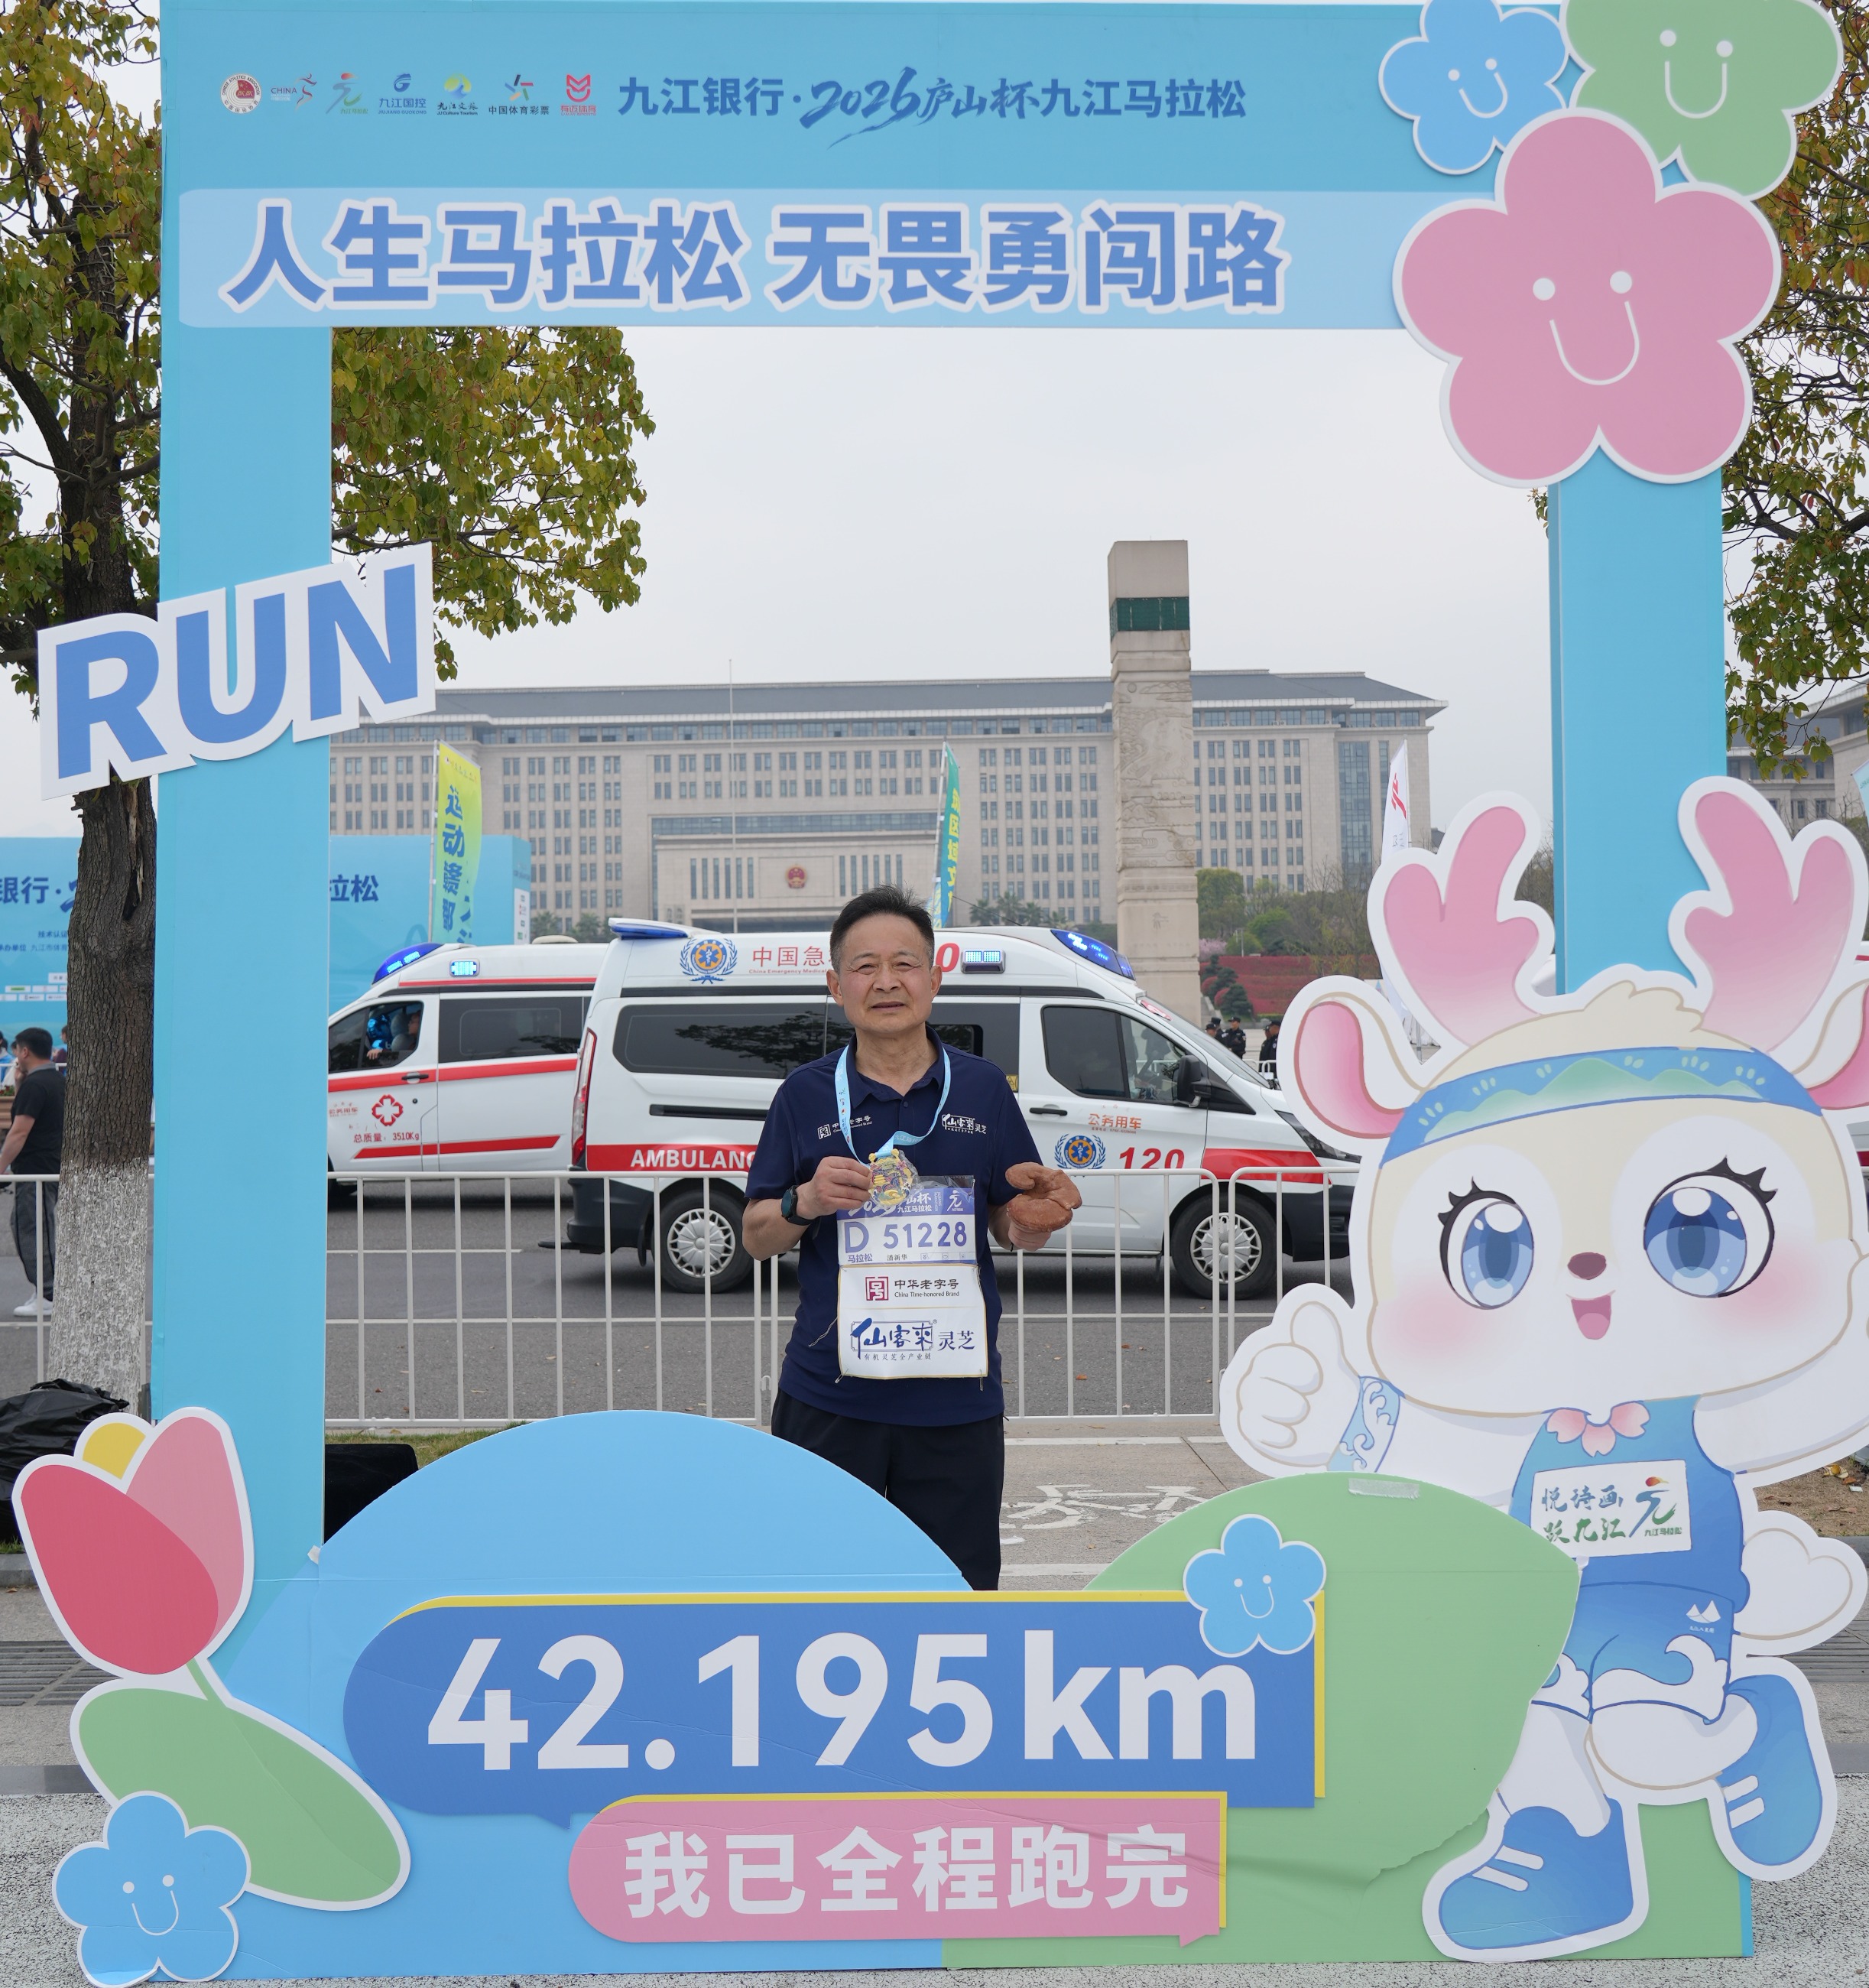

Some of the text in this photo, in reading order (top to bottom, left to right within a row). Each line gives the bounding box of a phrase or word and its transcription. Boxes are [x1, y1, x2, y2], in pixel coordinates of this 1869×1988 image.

[379, 98, 427, 108] 九江国控
[488, 106, 550, 115] 中国体育彩票
[224, 202, 1286, 309] 人生马拉松 无畏勇闯路
[55, 563, 419, 780] RUN
[753, 946, 832, 967] 中国急
[935, 942, 960, 973] 0
[1088, 1113, 1142, 1130] 公务用车
[392, 1132, 420, 1141] 3510Kg
[1119, 1147, 1185, 1169] 120
[897, 1204, 933, 1213] 九江马拉松
[844, 1220, 967, 1254] D 51228
[847, 1253, 873, 1263] 马拉松
[894, 1278, 959, 1290] 中华老字号
[937, 1330, 975, 1351] 灵芝
[864, 1353, 932, 1361] 有机灵芝全产业链
[1542, 1484, 1624, 1512] 悦诗画
[622, 1823, 1190, 1918] 我已全程跑完
